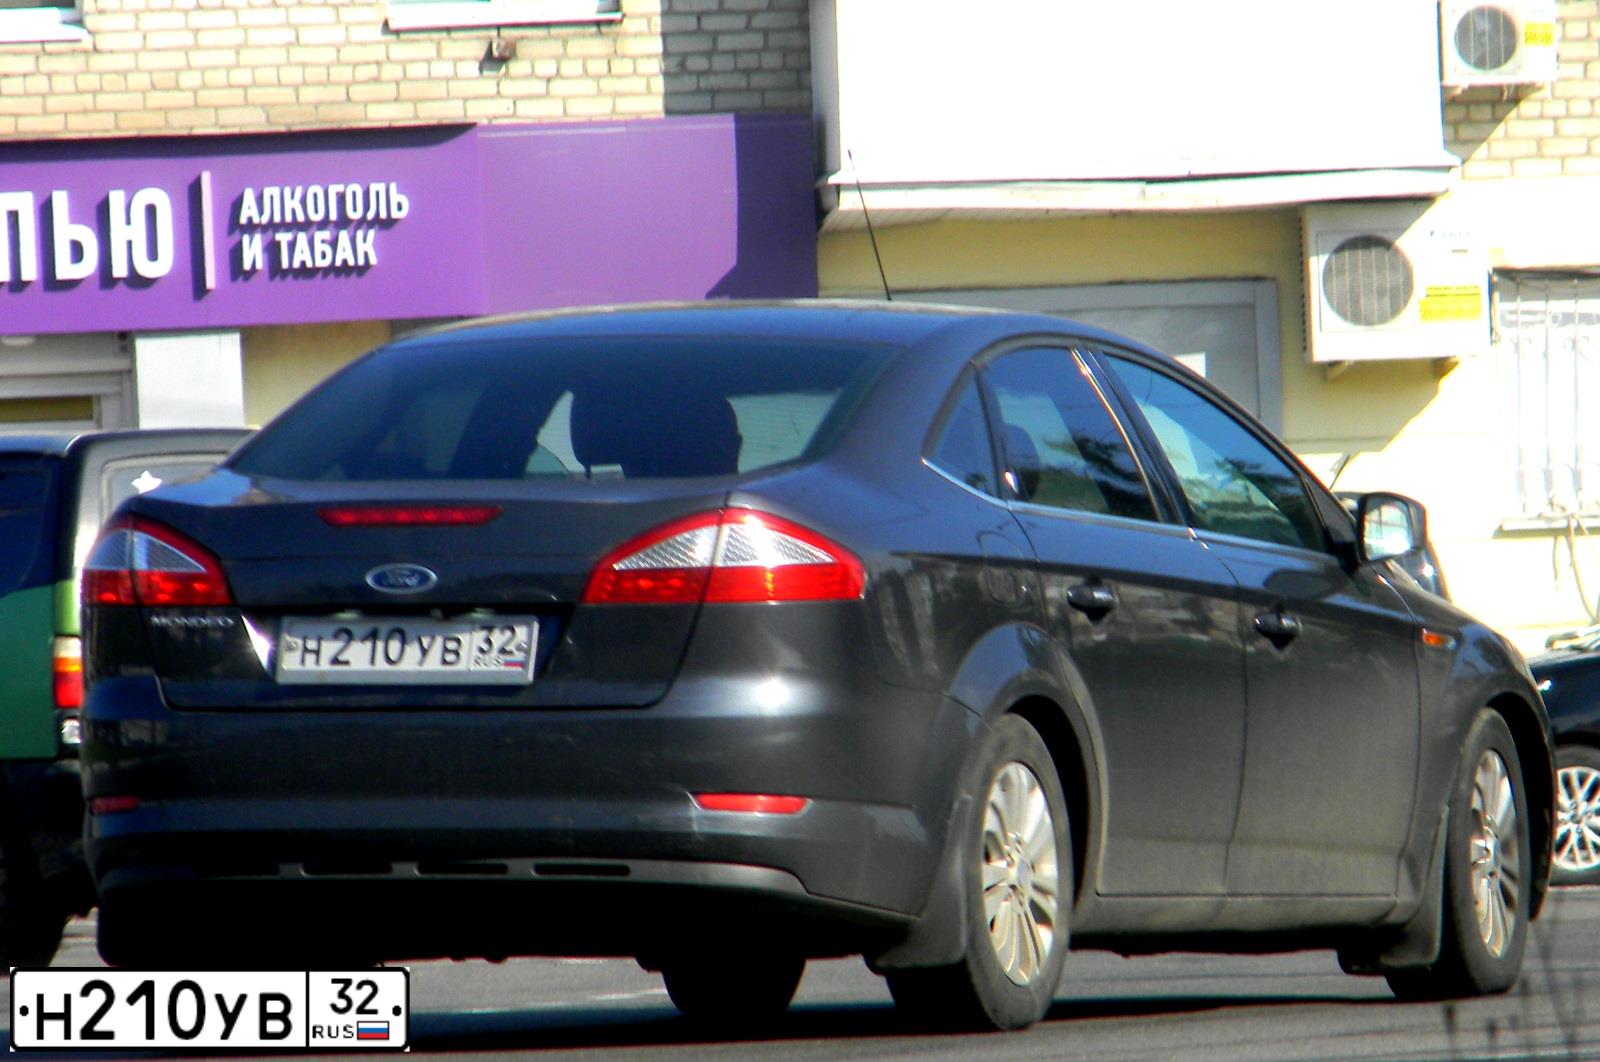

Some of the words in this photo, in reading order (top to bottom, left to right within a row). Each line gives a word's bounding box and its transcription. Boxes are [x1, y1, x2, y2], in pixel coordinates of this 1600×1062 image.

[238, 182, 409, 225] АЛКОГОЛЬ
[241, 233, 263, 271] И
[275, 229, 378, 270] ТАБАК
[477, 625, 517, 656] 32
